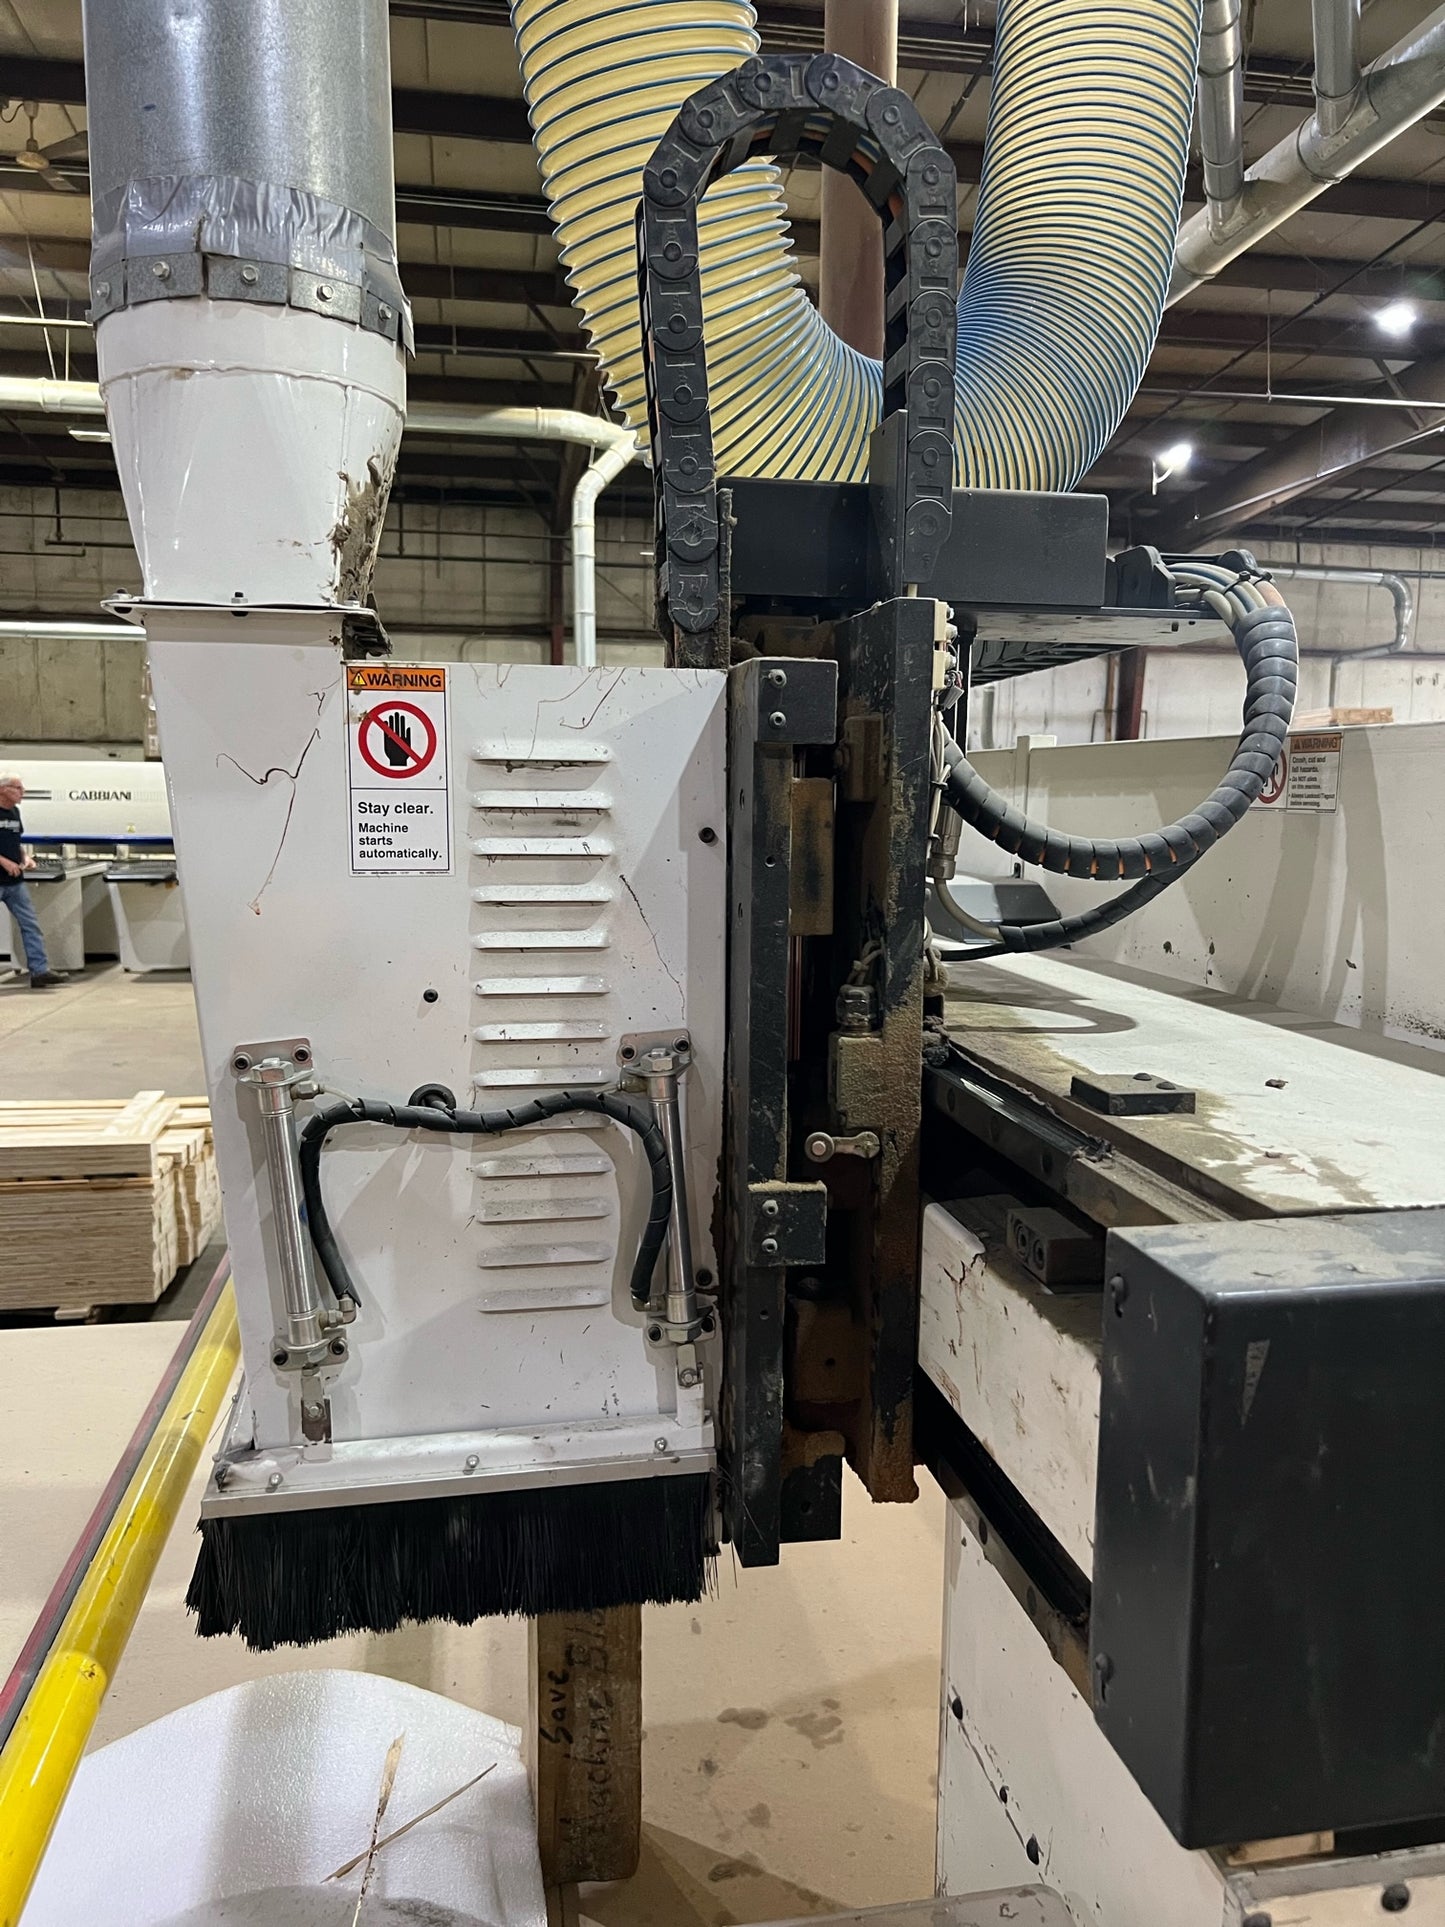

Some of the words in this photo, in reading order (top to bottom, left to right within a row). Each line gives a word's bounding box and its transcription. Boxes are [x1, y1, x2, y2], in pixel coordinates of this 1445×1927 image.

[367, 673, 442, 687] WARNING
[1302, 737, 1338, 749] WARNING
[68, 790, 132, 801] GABBIANI
[358, 801, 390, 817] Stay
[394, 801, 434, 814] clear.
[358, 822, 409, 833] Machine
[359, 836, 393, 846] starts
[359, 848, 442, 861] automatically.
[539, 1668, 573, 1745] Save
